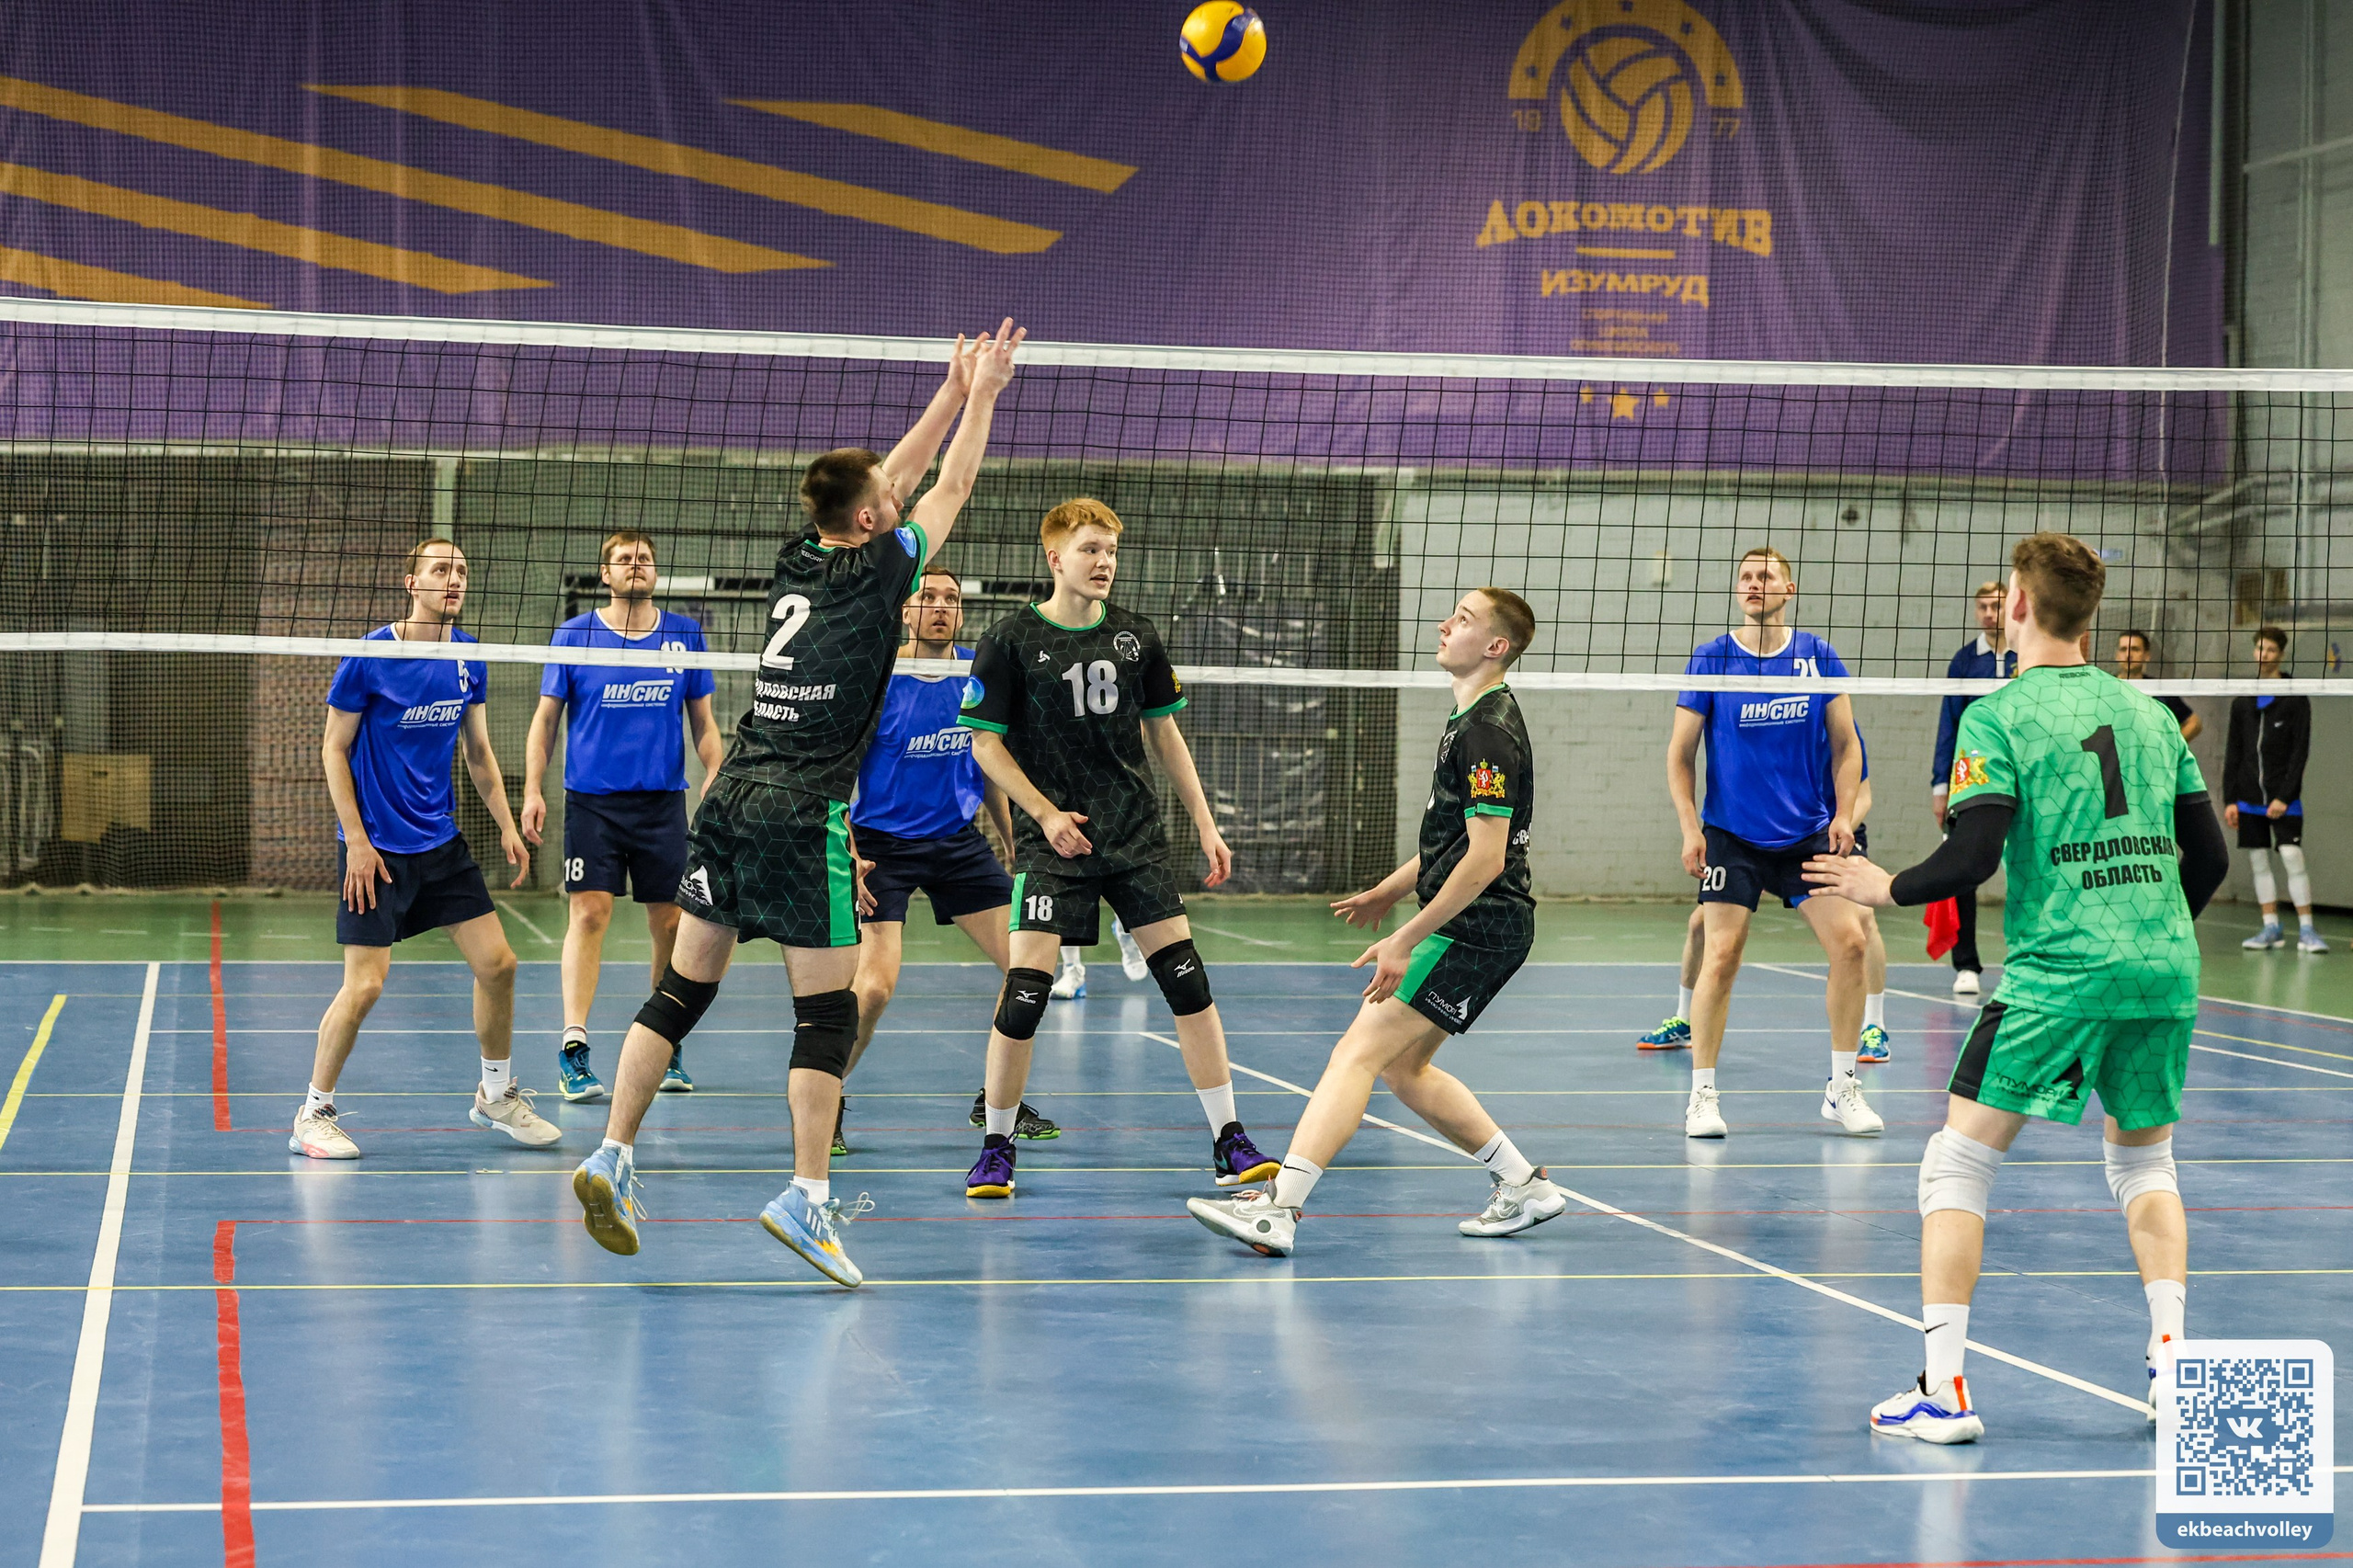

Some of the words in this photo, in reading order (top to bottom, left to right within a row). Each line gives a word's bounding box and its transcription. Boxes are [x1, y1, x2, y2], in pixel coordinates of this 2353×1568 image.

[1476, 199, 1772, 257] ЛОКОМОТИВ
[1540, 269, 1710, 309] ИЗУМРУД
[761, 594, 811, 670] 2
[602, 680, 674, 702] ИНСИС
[755, 678, 836, 701] ДЛОВСКАЯ
[1062, 660, 1119, 717] 18
[400, 699, 463, 723] ИНСИС
[754, 700, 800, 722] ЛАСТЬ
[1740, 696, 1810, 722] ИНСИС
[2081, 724, 2129, 820] 1
[564, 858, 585, 882] 18
[1701, 866, 1727, 892] 20
[2082, 864, 2163, 890] ОБЛАСТЬ
[1025, 894, 1053, 922] 18
